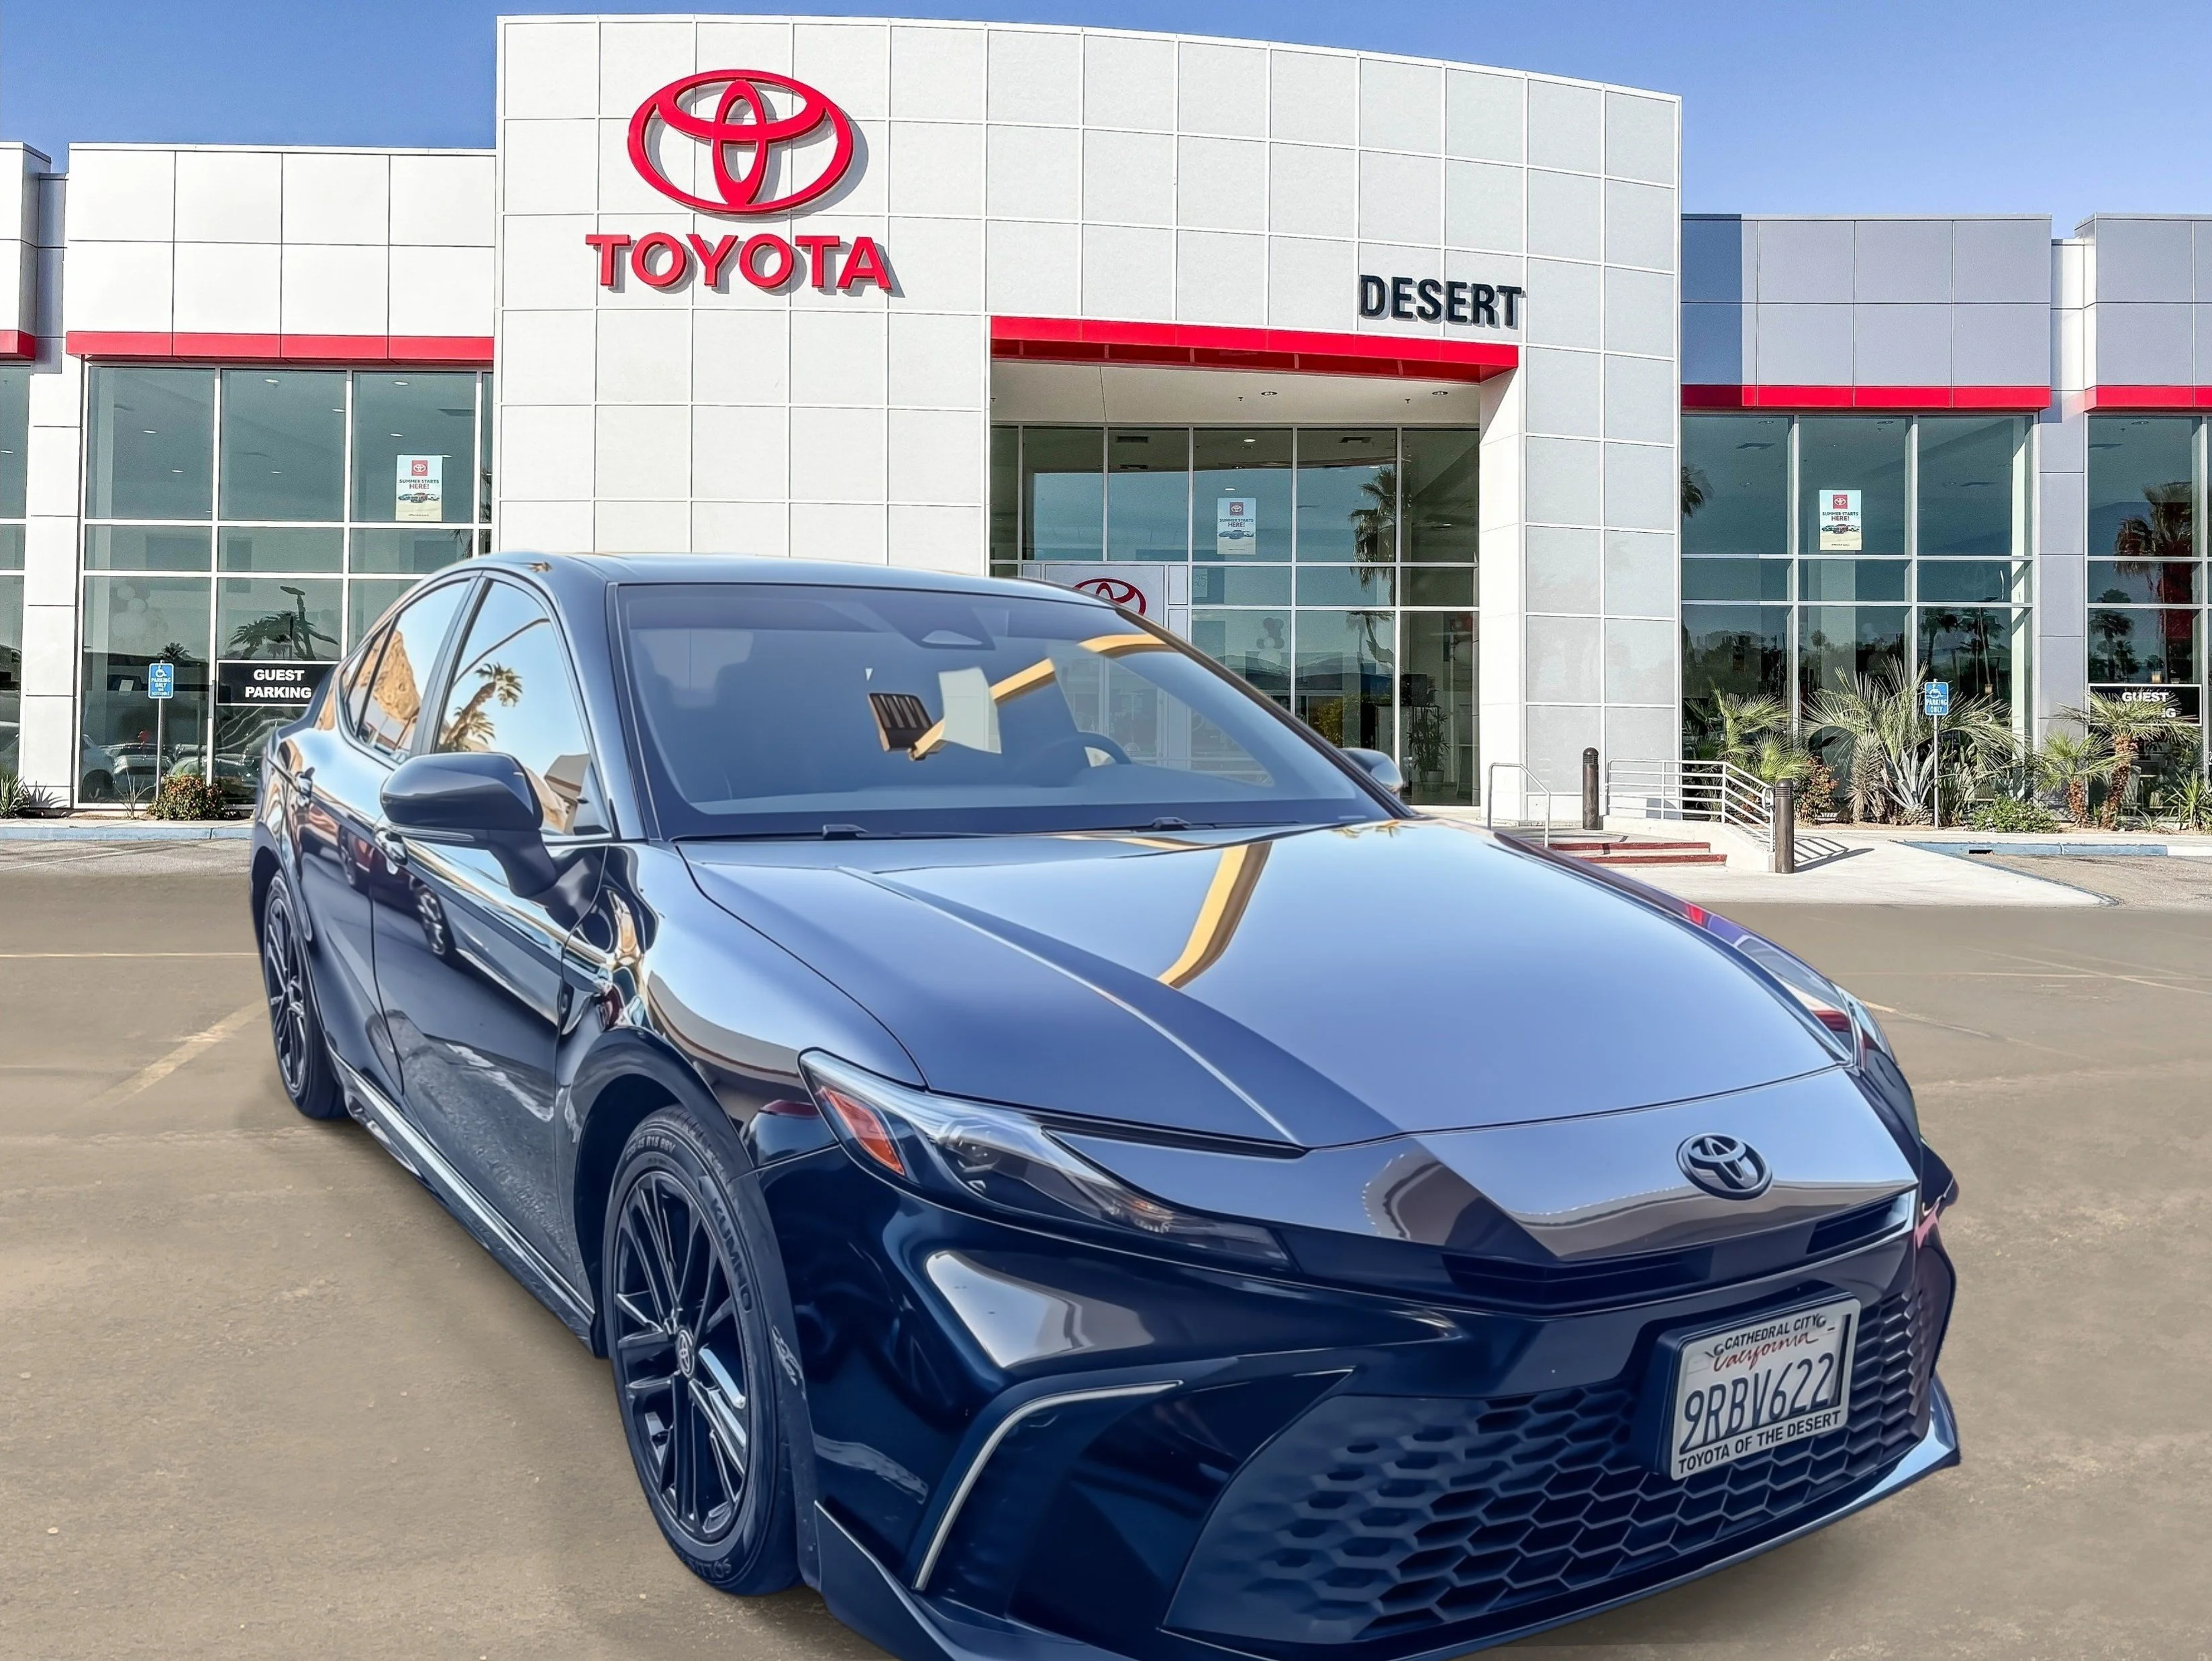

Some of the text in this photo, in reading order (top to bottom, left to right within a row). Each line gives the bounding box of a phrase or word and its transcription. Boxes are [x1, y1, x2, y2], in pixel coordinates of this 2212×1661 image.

[585, 232, 892, 290] TOYOTA
[1359, 274, 1521, 326] DESERT
[245, 687, 311, 699] PARKING
[254, 669, 305, 681] GUEST
[2122, 692, 2169, 702] GUEST
[1725, 1313, 1820, 1350] CATHEDRAL CITY
[1714, 1332, 1819, 1372] California
[1679, 1352, 1834, 1455] 9RBV622
[1679, 1411, 1840, 1474] TOYOTA OF THE DESERT
